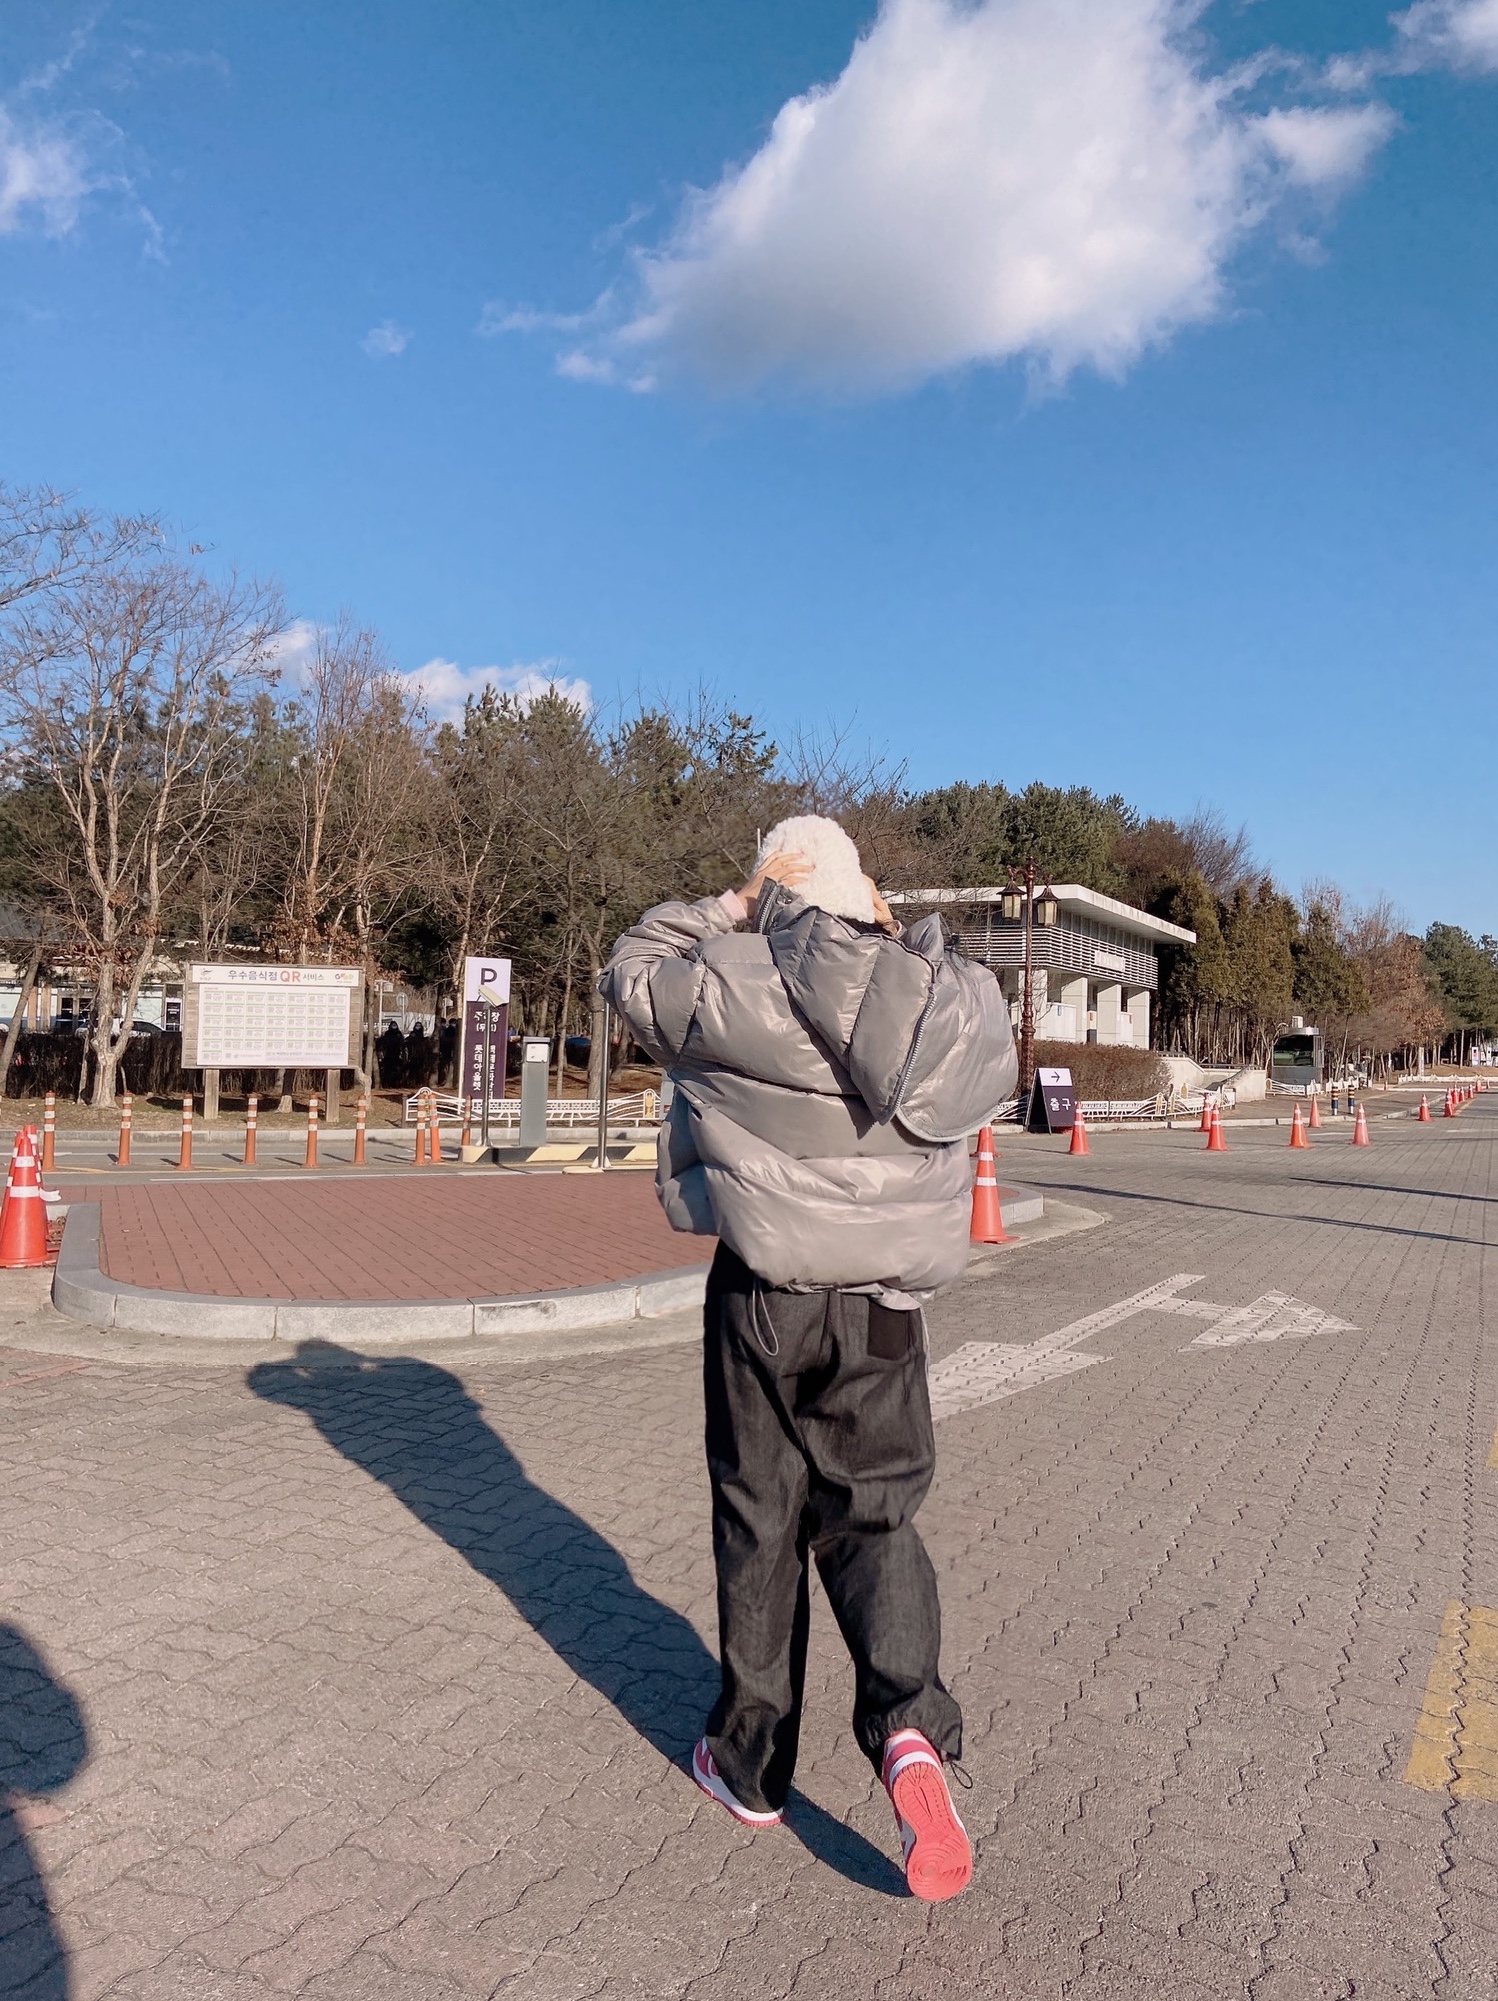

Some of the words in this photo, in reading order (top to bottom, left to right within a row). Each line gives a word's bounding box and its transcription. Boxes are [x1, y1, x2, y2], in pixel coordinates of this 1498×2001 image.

[228, 970, 278, 982] 우수음식점
[280, 970, 301, 982] QR
[302, 973, 325, 981] 서비스
[480, 967, 498, 986] P
[476, 1023, 497, 1032] (무)
[1049, 1097, 1072, 1112] 출구
